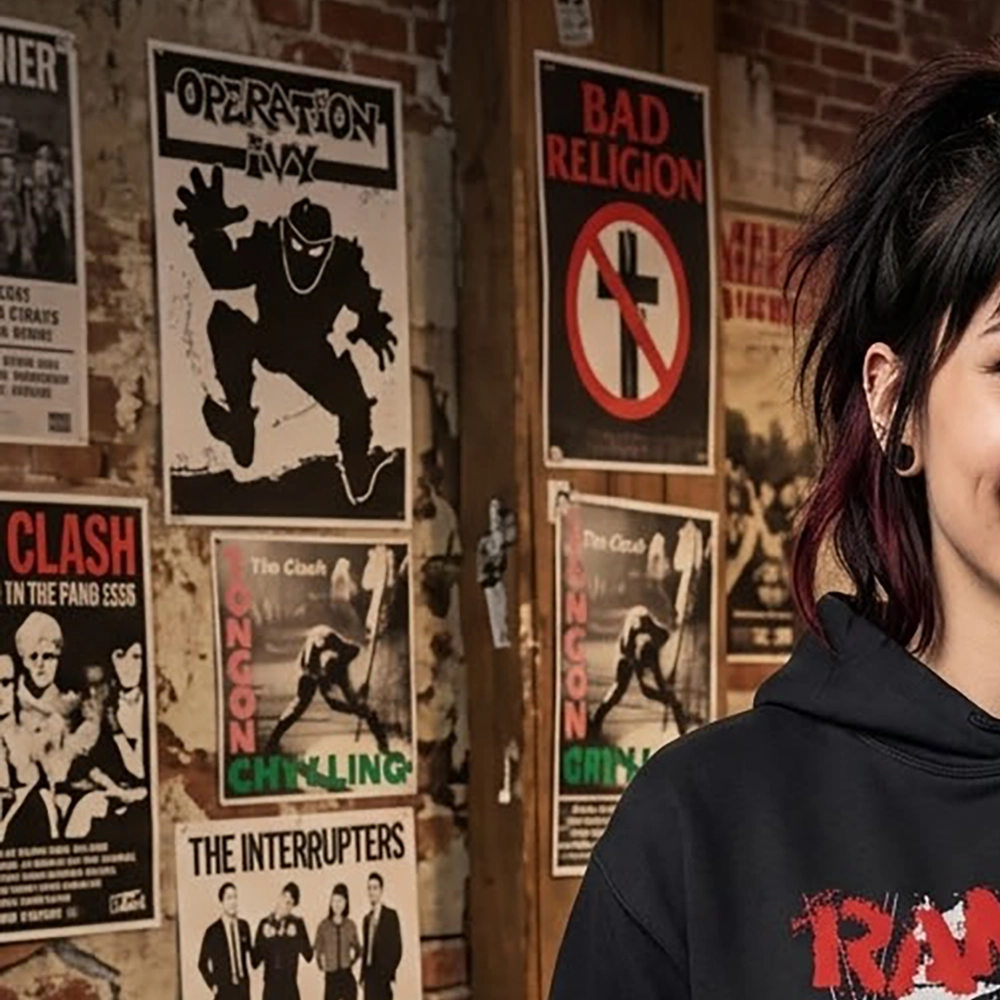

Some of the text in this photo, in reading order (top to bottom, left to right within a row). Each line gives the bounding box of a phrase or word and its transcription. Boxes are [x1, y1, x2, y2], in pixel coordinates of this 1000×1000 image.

[174, 67, 380, 149] OPERATION
[581, 80, 669, 146] BAD
[546, 133, 704, 205] RELIGION
[7, 510, 136, 577] CLASH
[27, 581, 57, 606] THE
[189, 822, 406, 877] THE INTERRUPTERS
